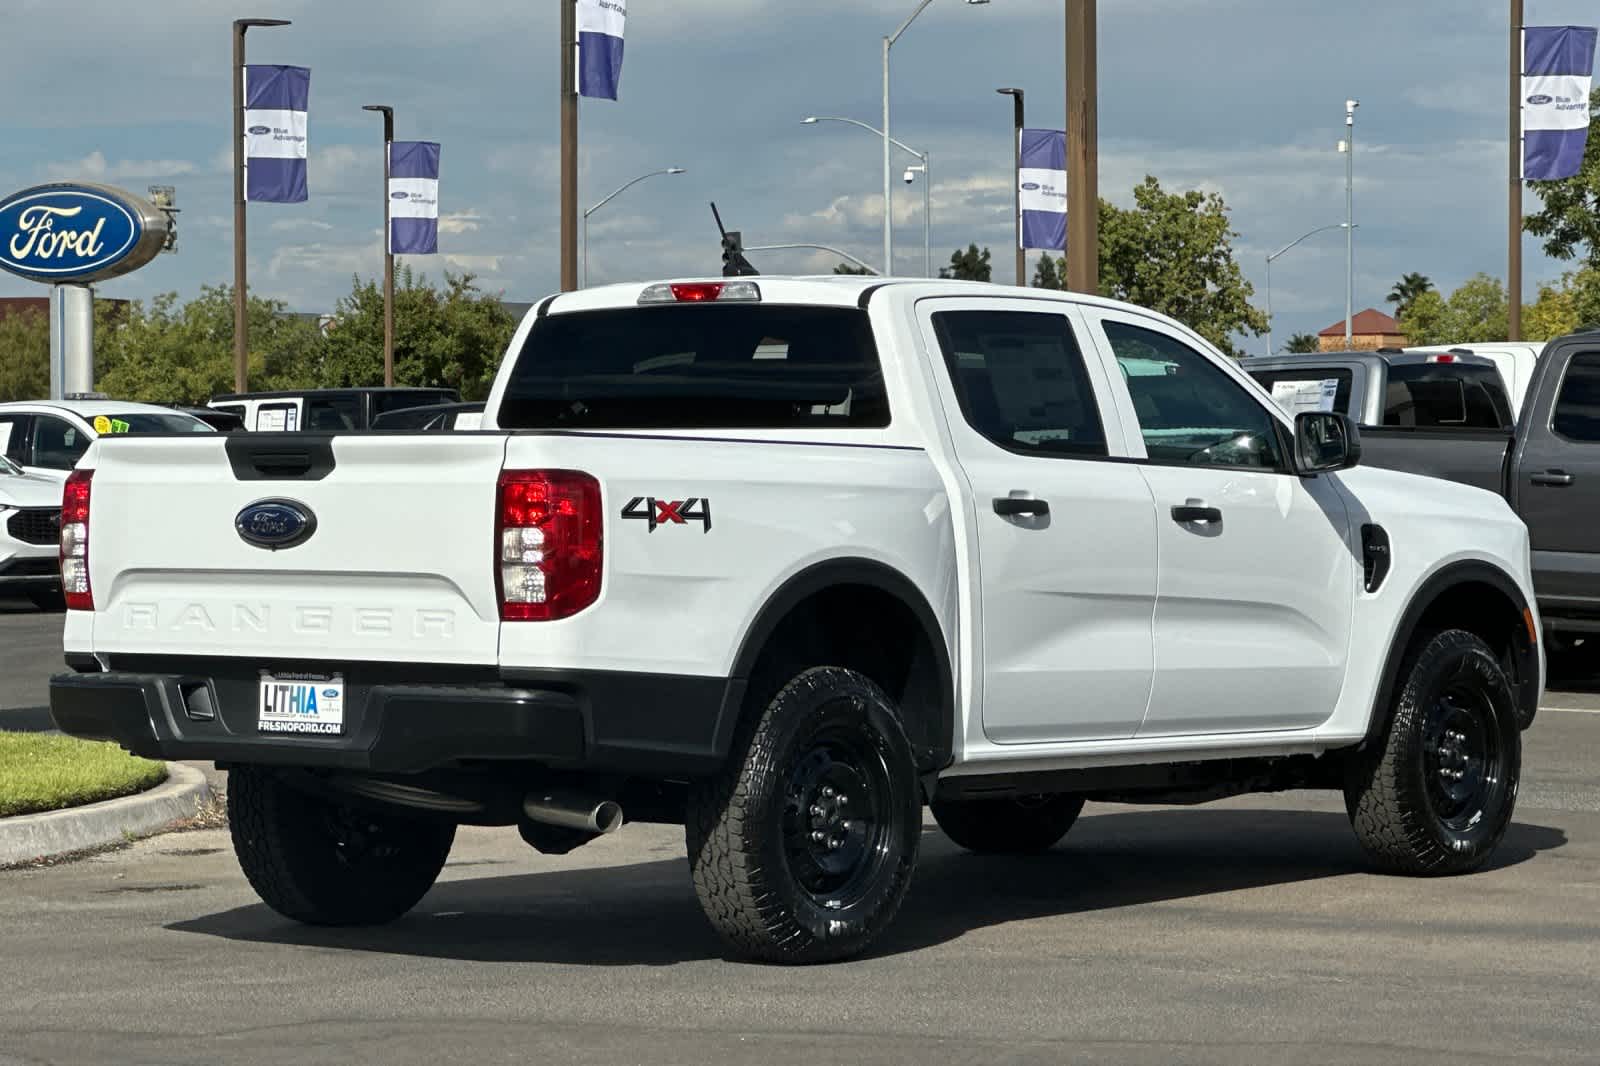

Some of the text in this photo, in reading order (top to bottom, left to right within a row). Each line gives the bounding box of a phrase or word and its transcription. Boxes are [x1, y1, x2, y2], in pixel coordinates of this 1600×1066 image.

[9, 205, 106, 260] Ford
[251, 511, 287, 532] Ford
[121, 601, 456, 639] RANGER
[263, 684, 318, 715] LITHIA
[257, 720, 341, 734] FRESNOFORD.COM
